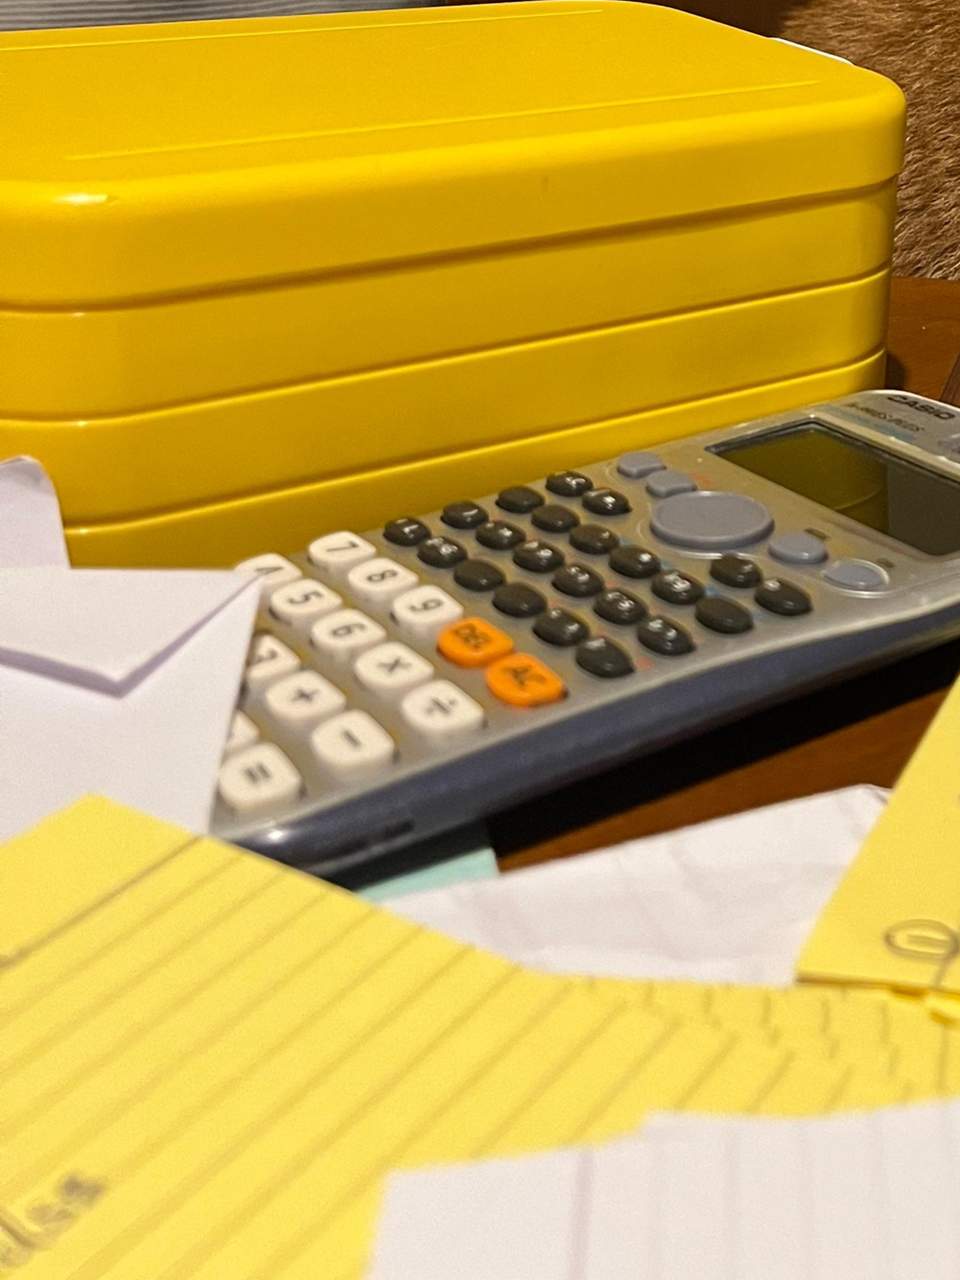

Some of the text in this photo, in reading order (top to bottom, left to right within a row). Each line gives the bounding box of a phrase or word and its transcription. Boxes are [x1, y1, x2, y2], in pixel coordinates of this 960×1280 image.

[326, 540, 359, 552] 7
[366, 569, 398, 582] 8
[409, 599, 443, 612] 9
[287, 590, 324, 604] 5
[331, 623, 367, 637] 6
